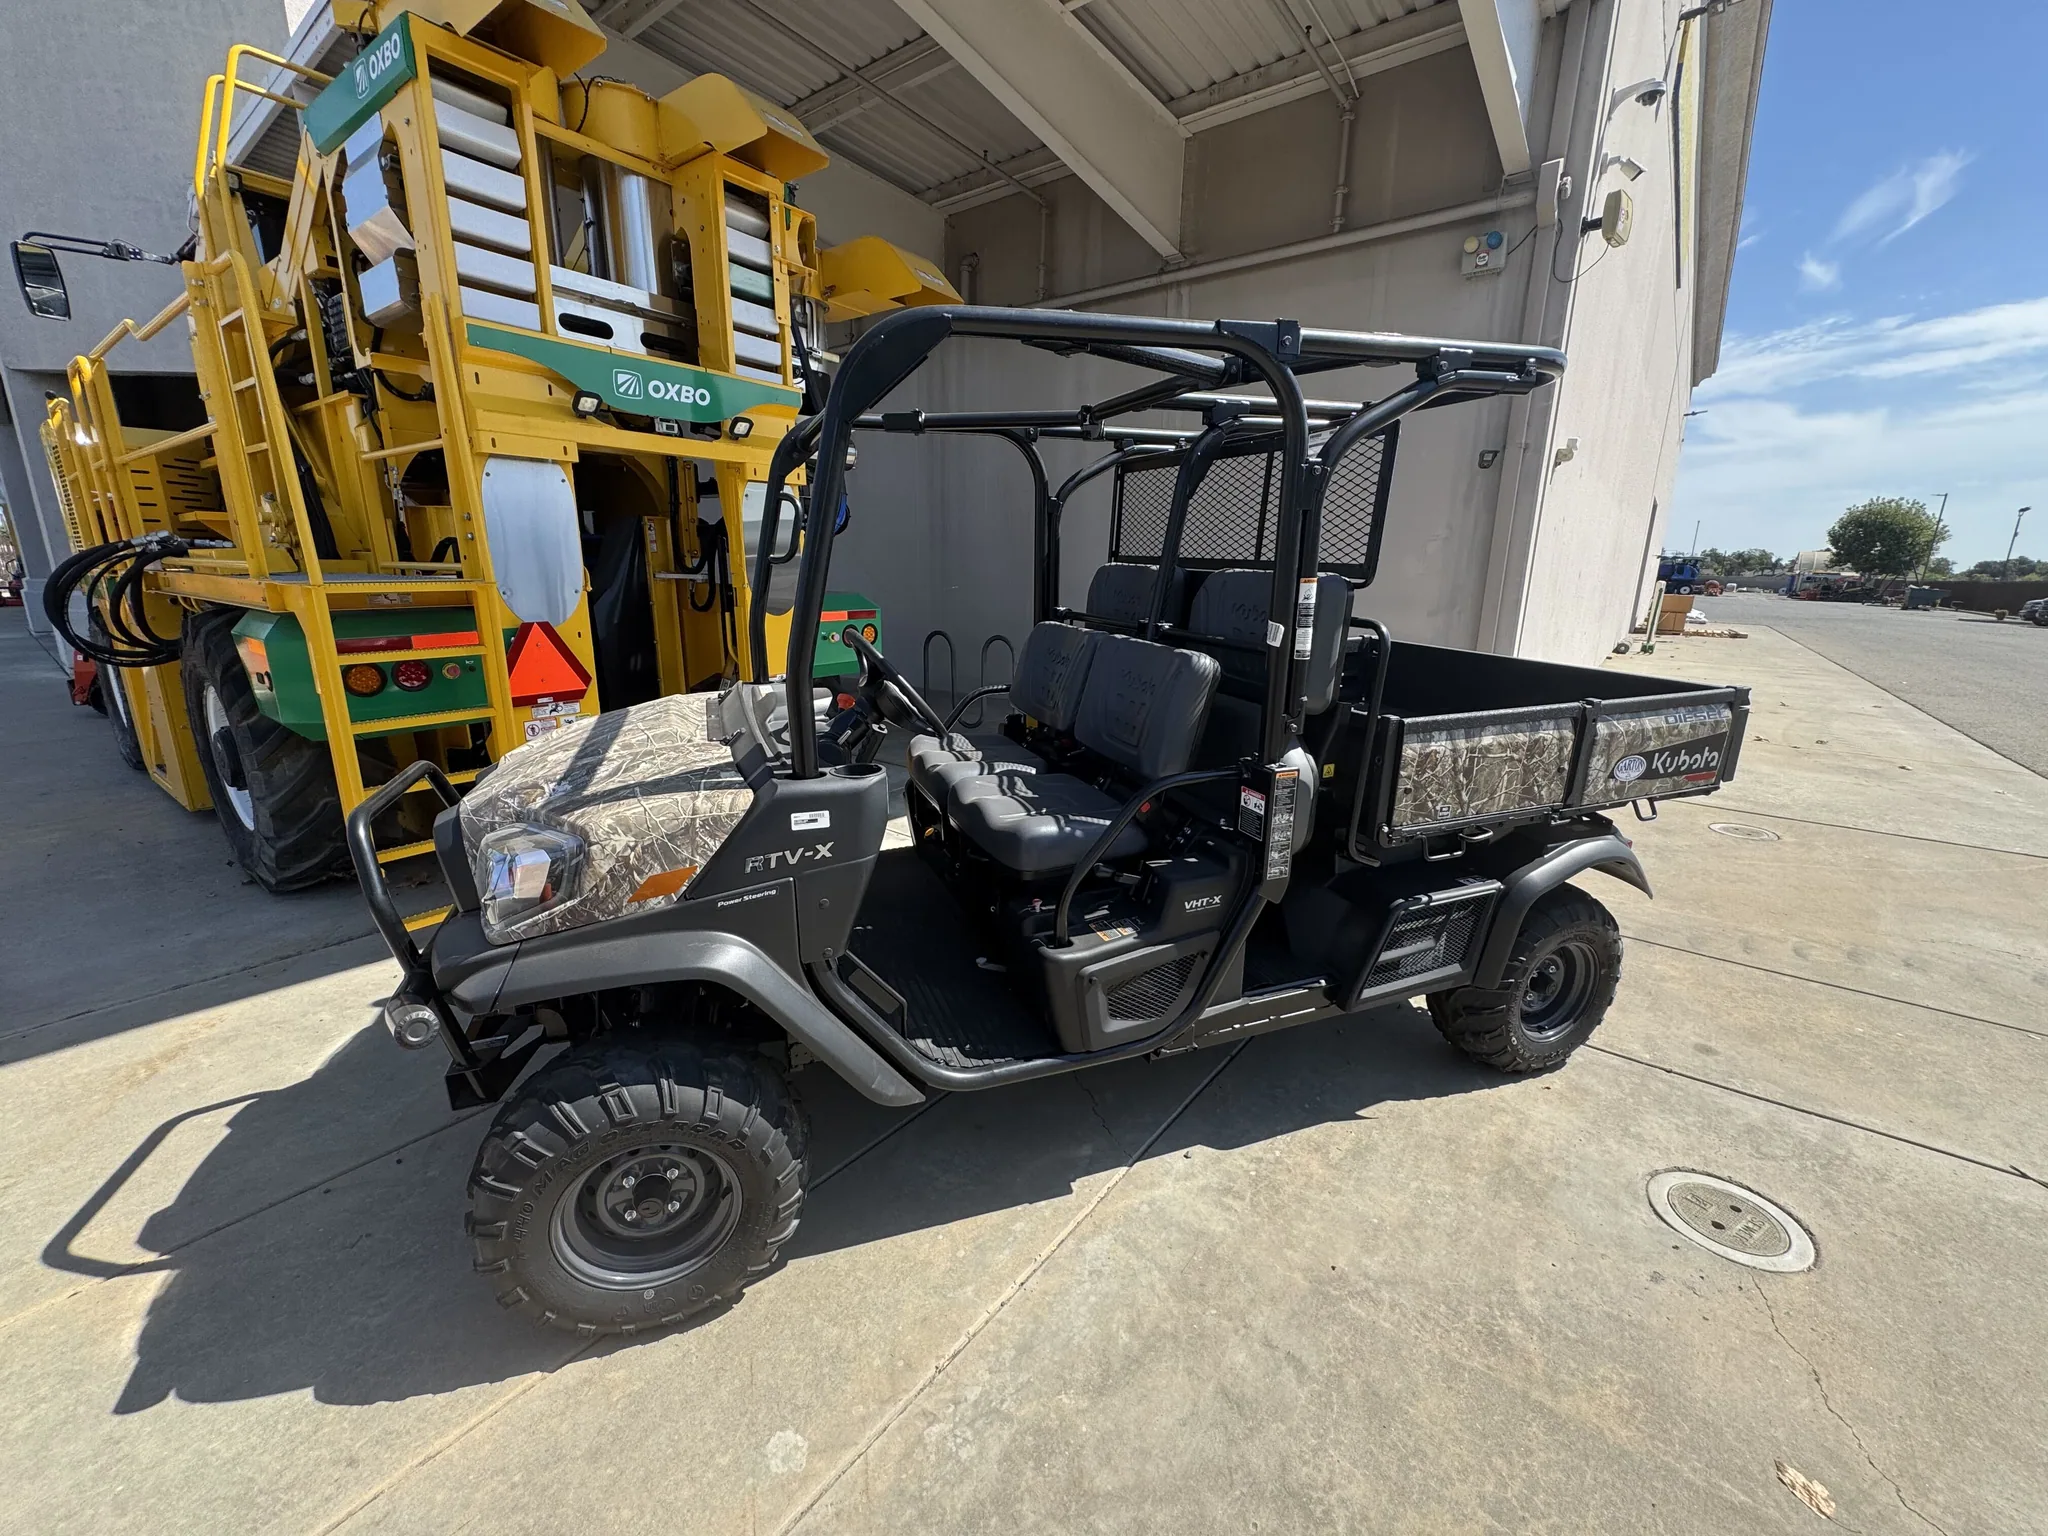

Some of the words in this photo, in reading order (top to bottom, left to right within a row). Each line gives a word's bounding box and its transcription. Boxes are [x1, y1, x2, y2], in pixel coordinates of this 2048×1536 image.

[369, 32, 400, 80] OXBO
[648, 380, 711, 406] OXBO
[1664, 711, 1729, 724] DIESEL
[1652, 746, 1719, 774] Kubota
[745, 841, 834, 873] RTV-X
[717, 897, 742, 908] Power
[743, 889, 776, 902] Steering
[1184, 895, 1222, 909] VHT-X
[668, 1120, 747, 1151] ROAD
